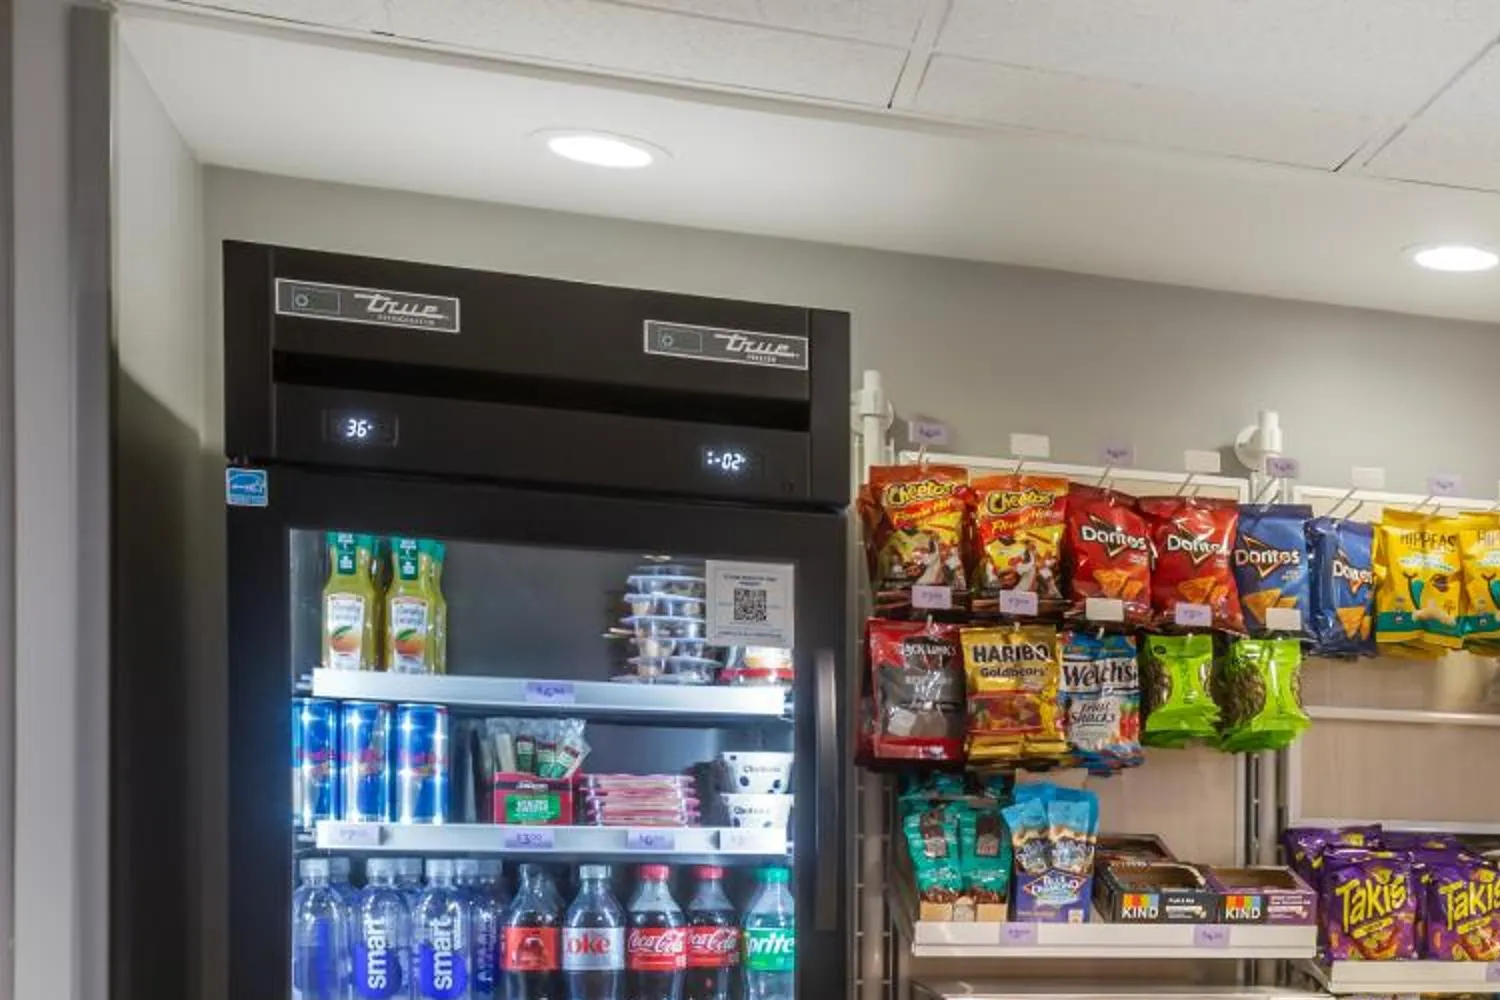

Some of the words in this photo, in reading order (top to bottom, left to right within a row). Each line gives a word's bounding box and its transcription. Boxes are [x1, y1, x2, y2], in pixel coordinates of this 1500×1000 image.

[1081, 526, 1147, 550] Doritos
[1235, 551, 1301, 566] Doritos
[973, 643, 1050, 663] HARIBO
[1062, 661, 1133, 686] Welch's
[1121, 907, 1159, 919] KIND
[1225, 907, 1261, 919] KIND
[1335, 874, 1407, 934] Takis
[364, 915, 388, 990] smart
[430, 916, 453, 991] smart
[746, 932, 794, 957] prite
